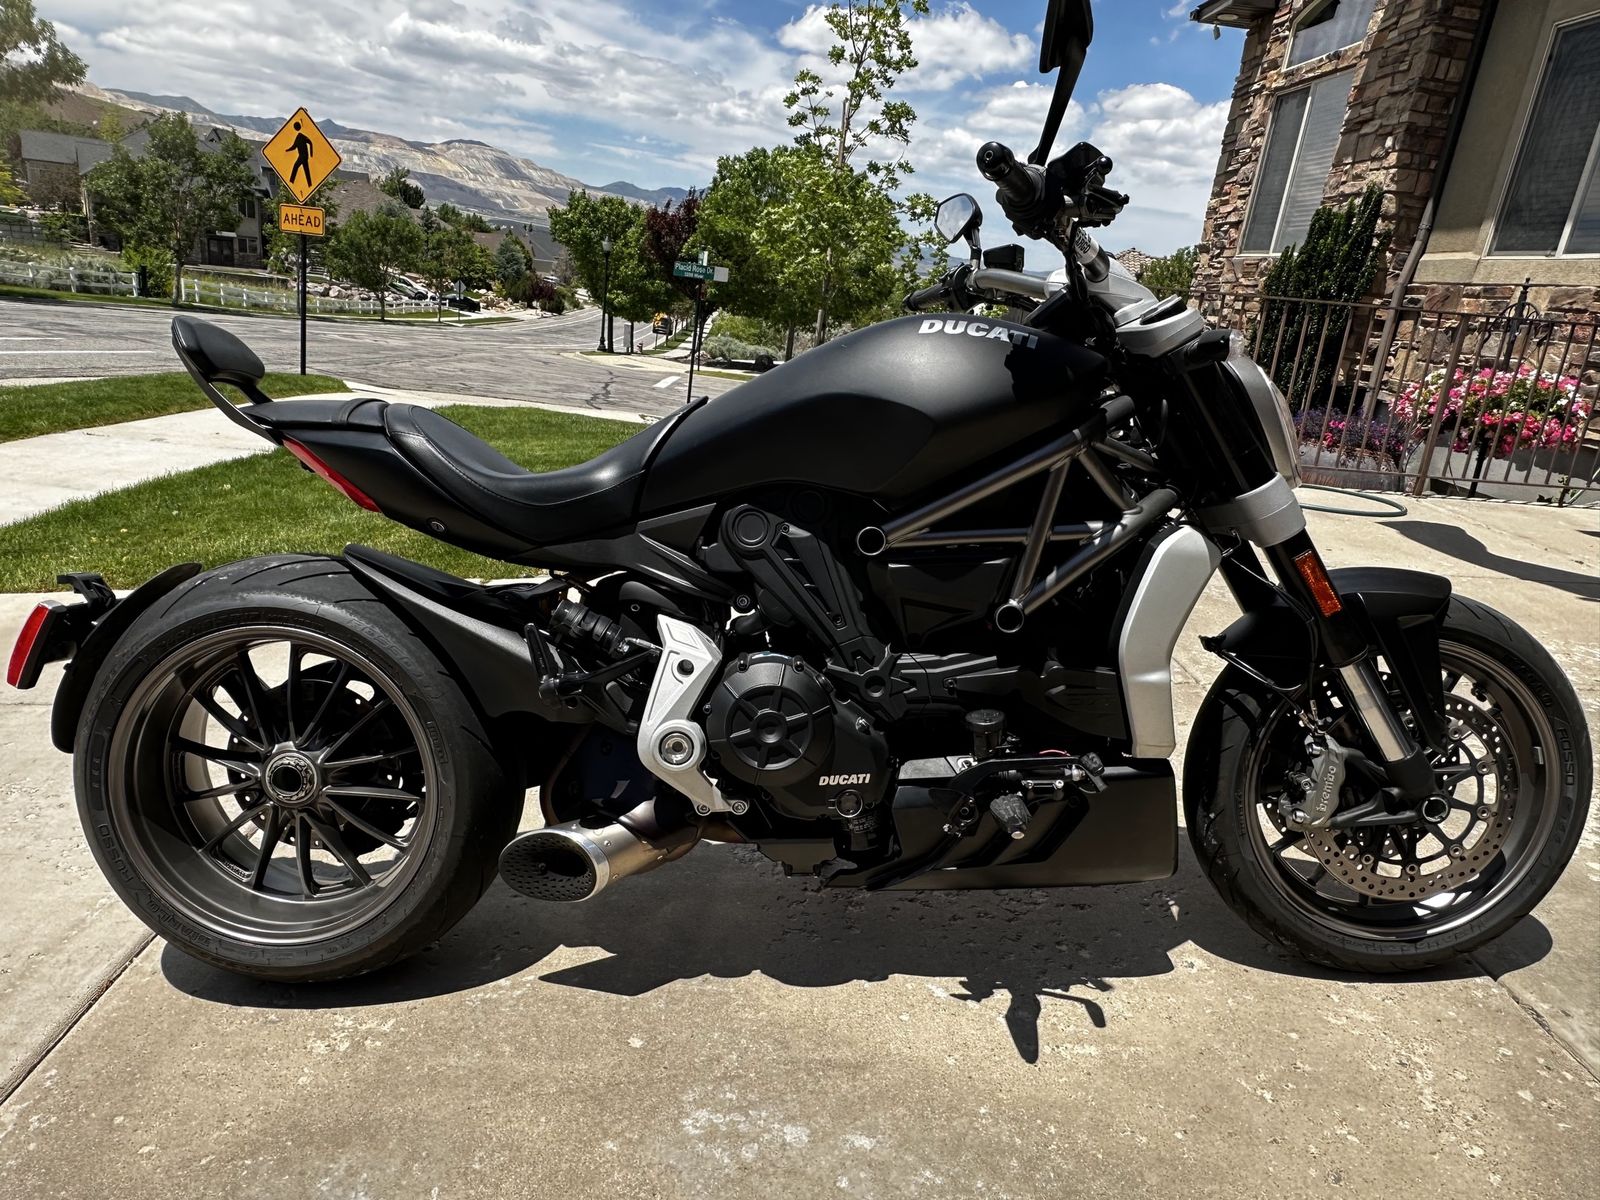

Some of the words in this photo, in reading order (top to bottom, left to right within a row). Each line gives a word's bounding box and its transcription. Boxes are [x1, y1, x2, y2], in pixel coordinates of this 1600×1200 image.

[283, 213, 321, 228] AHEAD
[918, 319, 1039, 349] DUCATI
[1556, 728, 1575, 786] ROSSO
[818, 773, 871, 786] DUCATI
[1315, 765, 1337, 812] brembo
